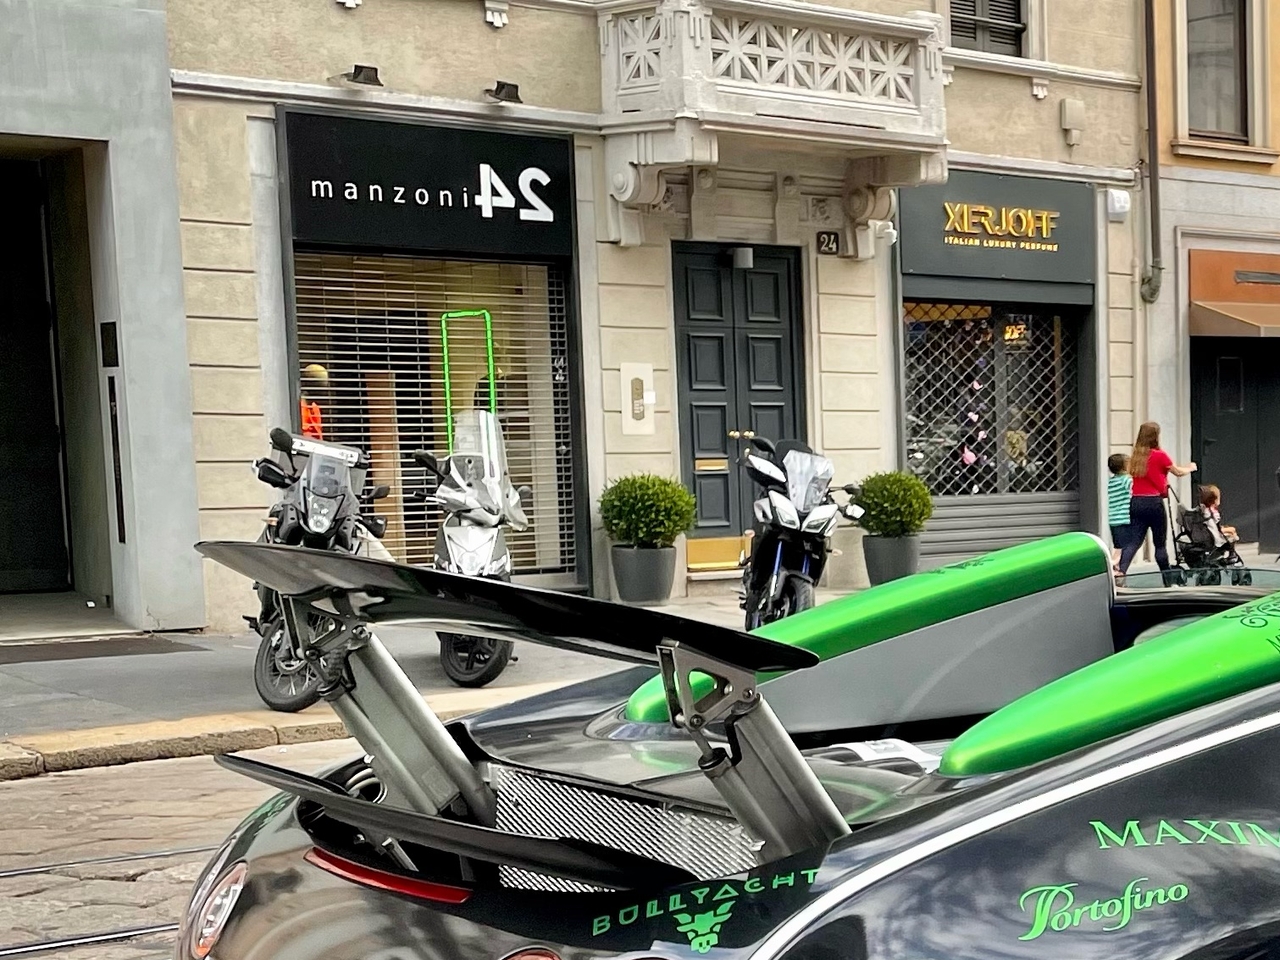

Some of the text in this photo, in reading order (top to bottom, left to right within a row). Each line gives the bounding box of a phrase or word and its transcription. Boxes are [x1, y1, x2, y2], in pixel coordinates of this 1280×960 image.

[311, 179, 468, 208] manzoni
[943, 201, 1060, 239] XERJOFF
[820, 233, 837, 252] 24
[944, 236, 1058, 252] ITALIAN LUXURY PERFUME
[1018, 877, 1189, 941] Portofino
